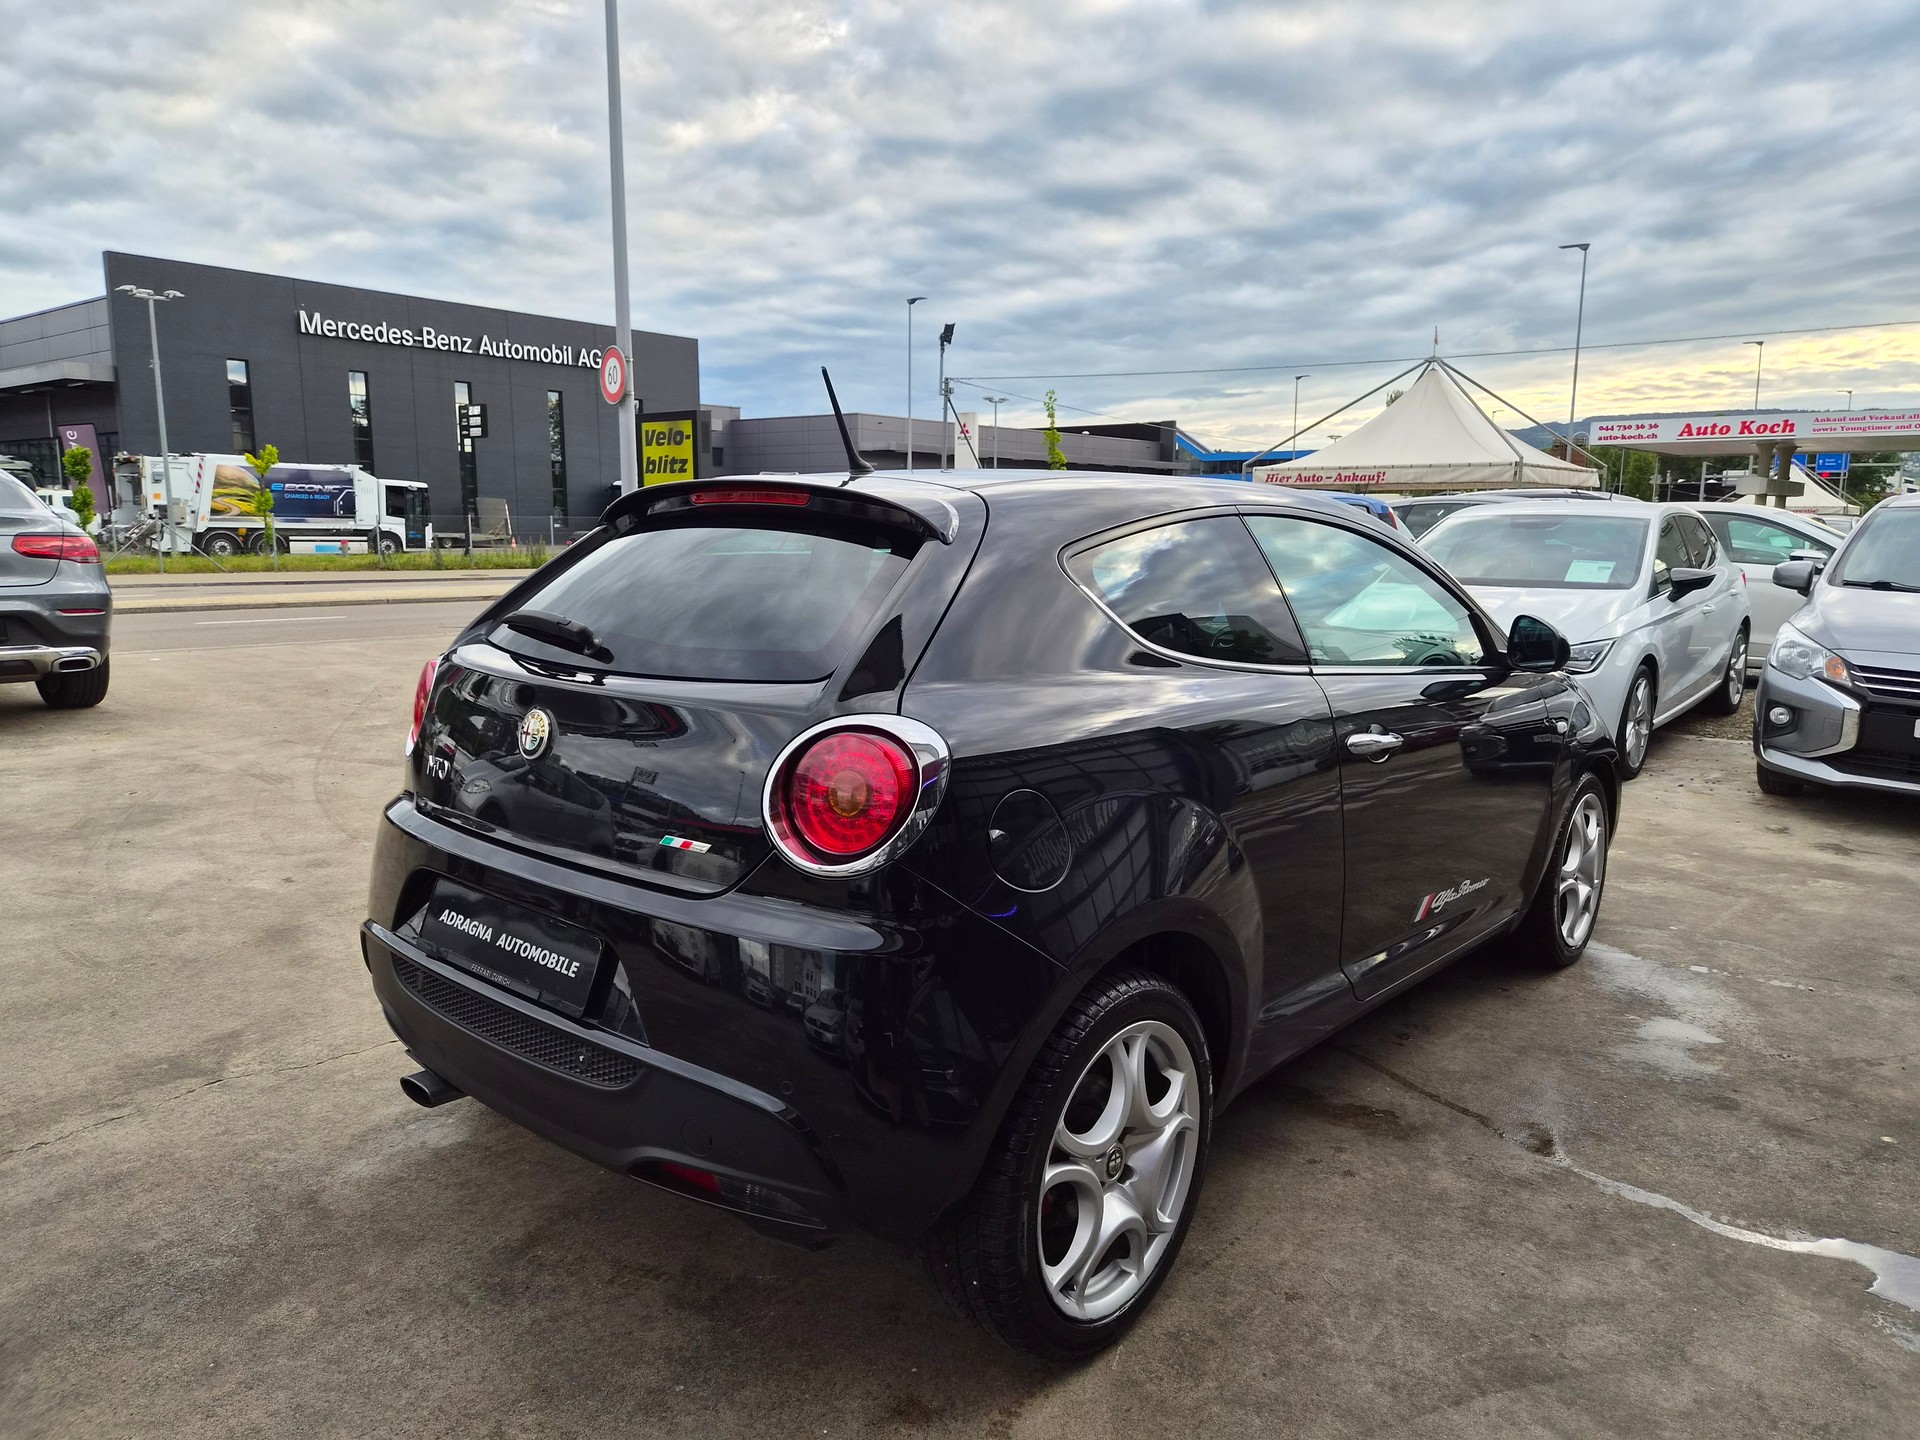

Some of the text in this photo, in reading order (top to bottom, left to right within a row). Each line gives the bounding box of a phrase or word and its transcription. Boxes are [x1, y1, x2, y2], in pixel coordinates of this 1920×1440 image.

[299, 310, 602, 369] Mercedes-Benz Automobil AG
[607, 365, 618, 385] 60
[644, 428, 691, 447] Velo-
[1598, 433, 1658, 441] auto-koch.ch
[1678, 419, 1795, 437] Auto Koch
[1840, 425, 1892, 433] Youngtimer
[644, 455, 688, 474] blitz
[1265, 473, 1291, 483] Hier
[1431, 877, 1490, 913] Alfa Romeo
[439, 909, 580, 978] ADRAGNA AUTOMOBILE
[471, 963, 492, 977] FERRARI
